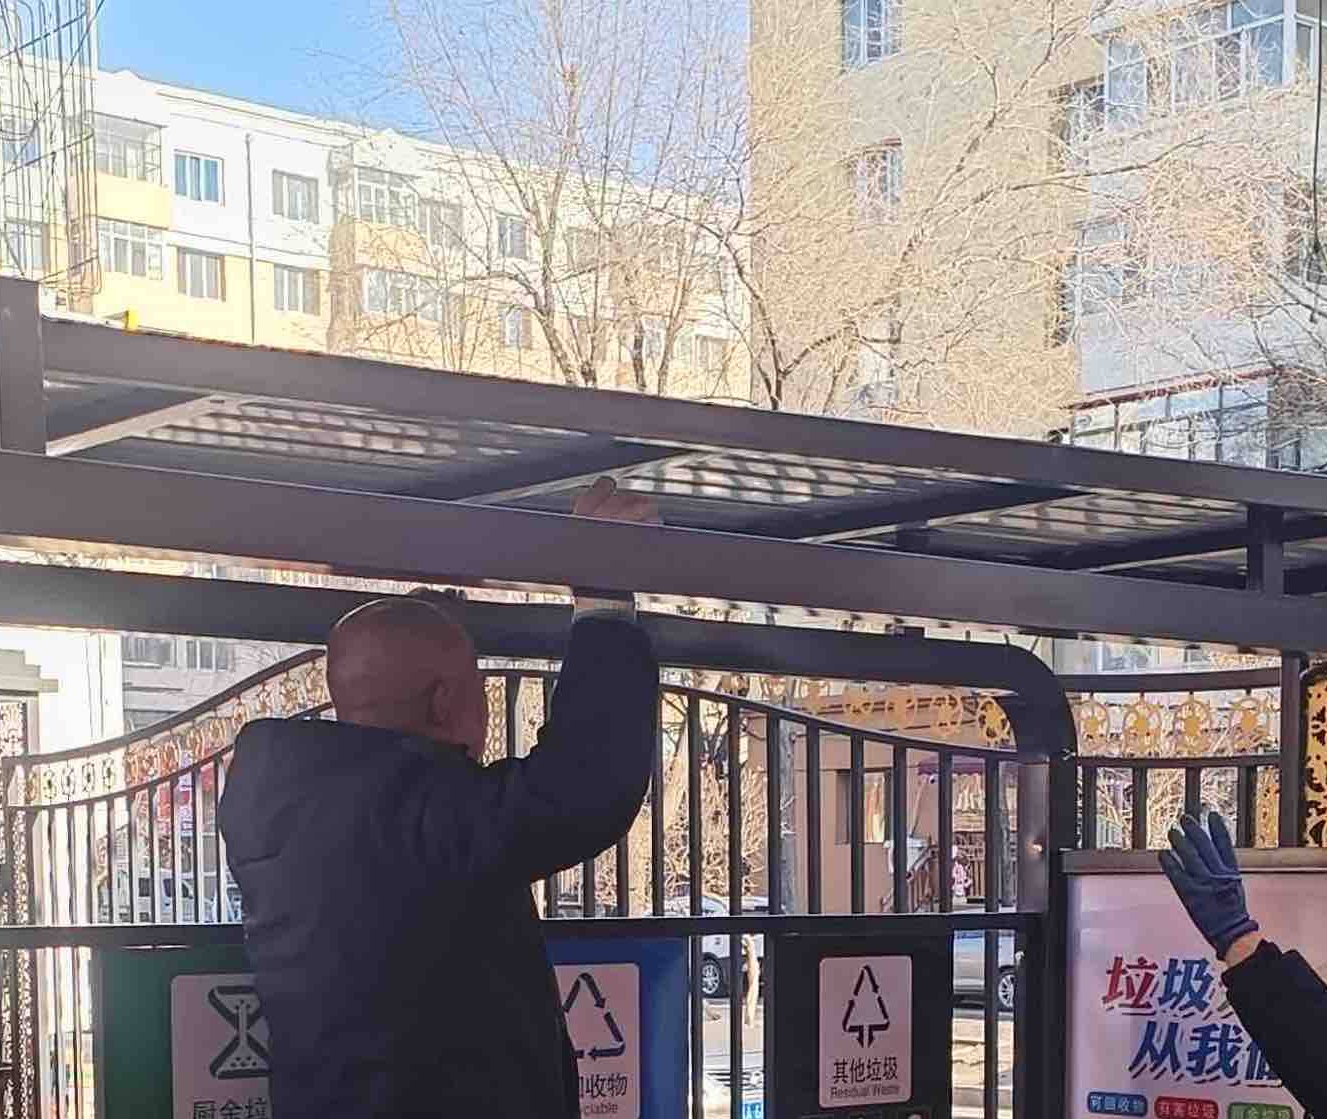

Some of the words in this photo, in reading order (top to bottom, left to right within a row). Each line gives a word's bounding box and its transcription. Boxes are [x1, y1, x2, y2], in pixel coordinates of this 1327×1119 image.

[1102, 956, 1231, 1018] 垃圾
[833, 1056, 898, 1084] 其他垃圾
[578, 1073, 627, 1098] 收物
